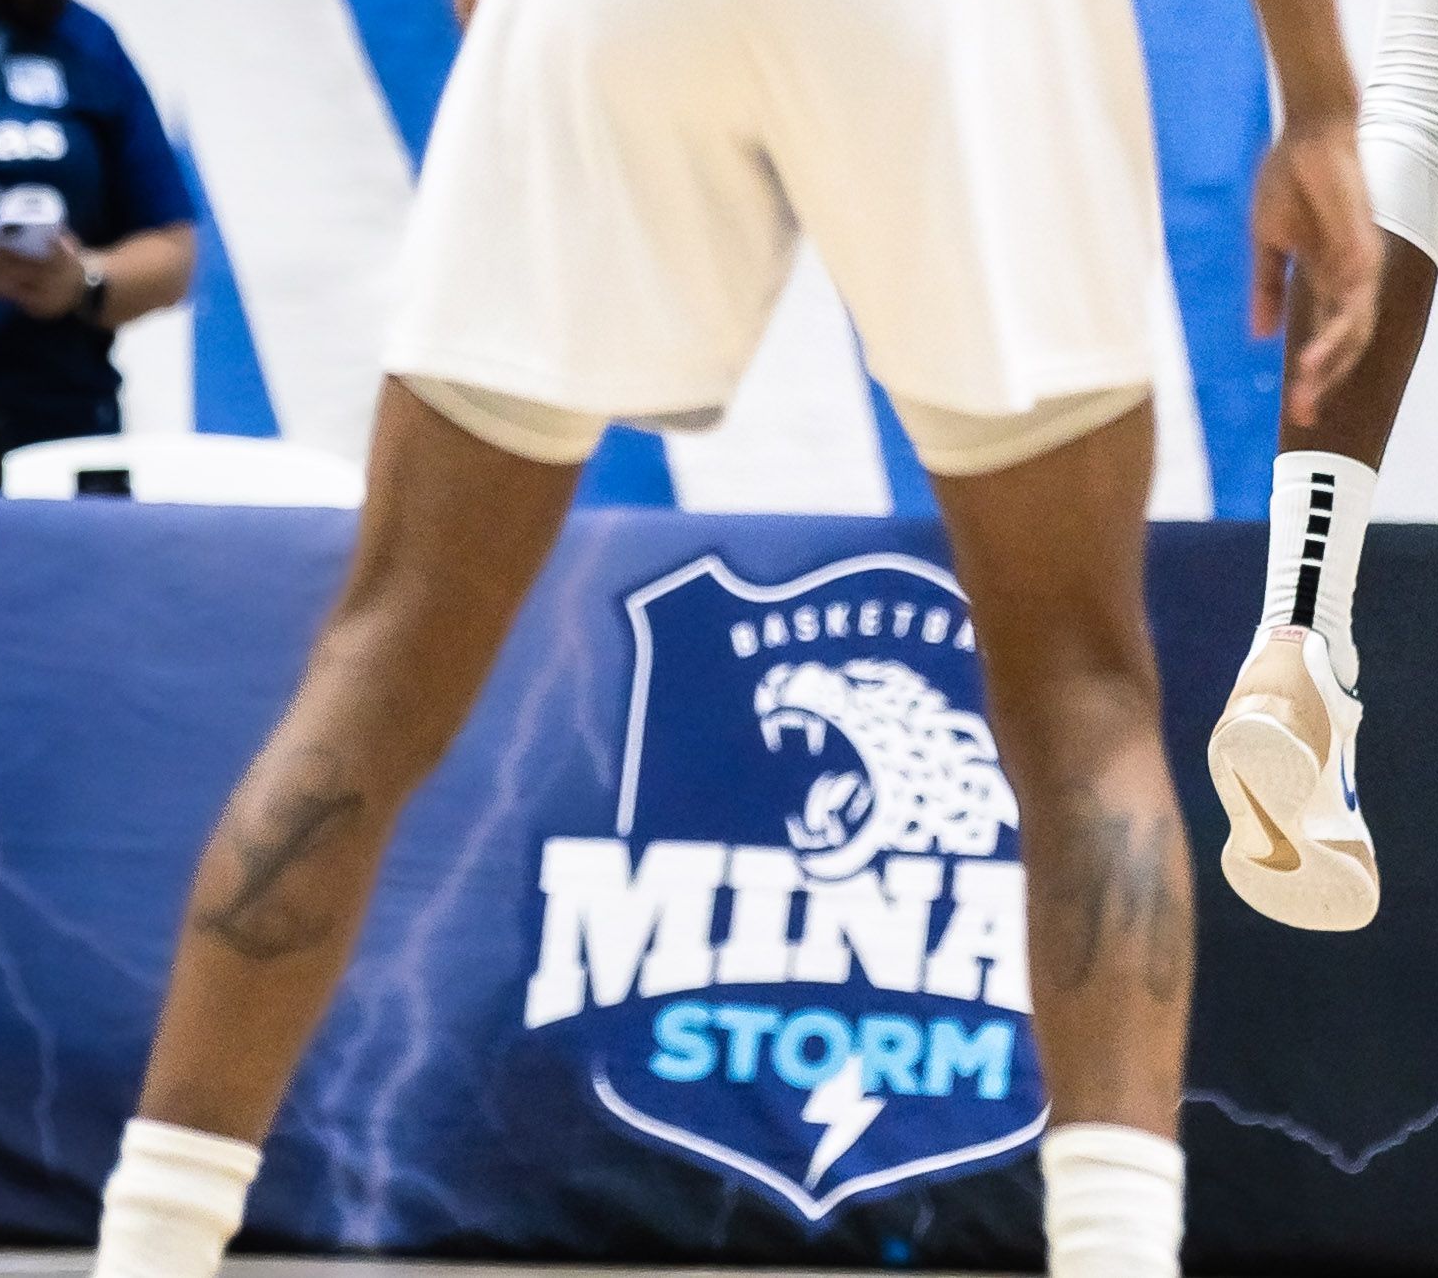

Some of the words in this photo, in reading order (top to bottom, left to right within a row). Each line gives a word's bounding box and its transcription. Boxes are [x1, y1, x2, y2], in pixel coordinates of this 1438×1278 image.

[730, 601, 975, 657] BASKETBA
[524, 835, 1034, 1030] MINA
[648, 998, 1016, 1100] STORM
